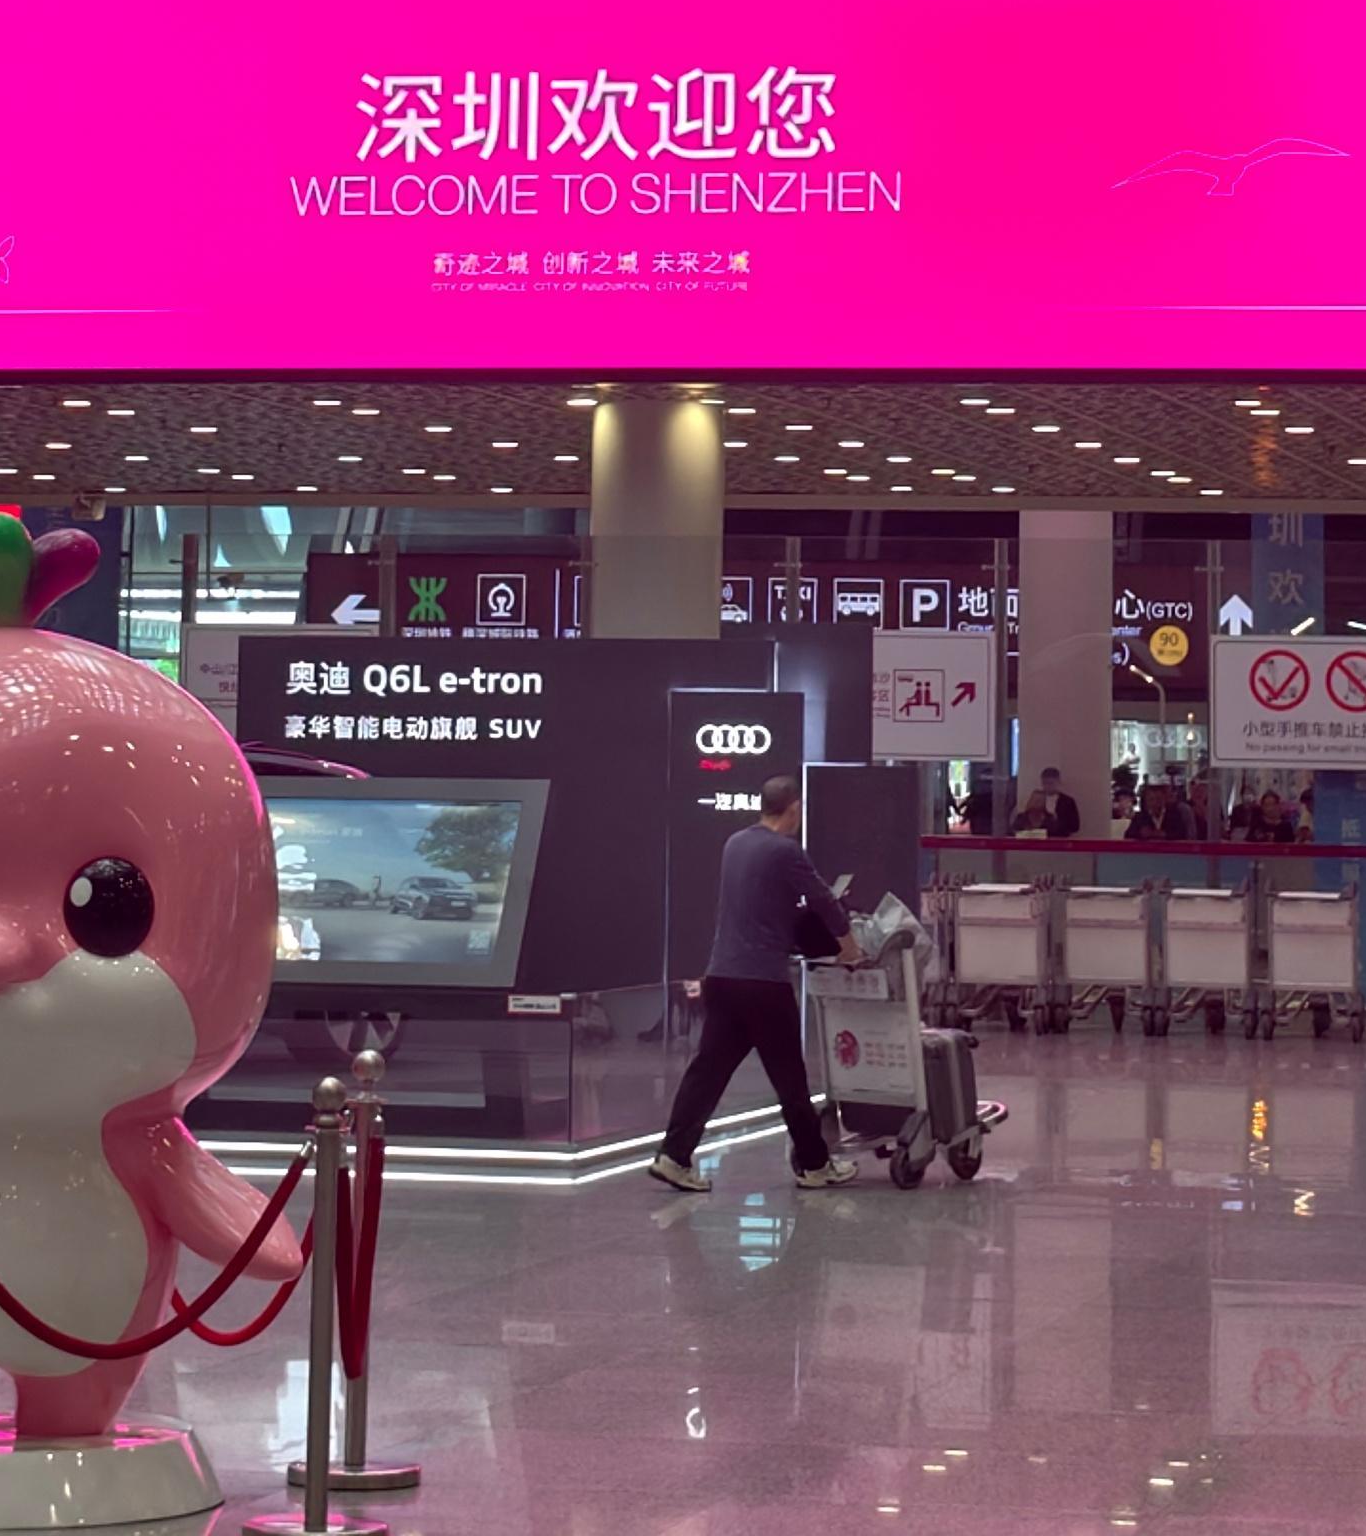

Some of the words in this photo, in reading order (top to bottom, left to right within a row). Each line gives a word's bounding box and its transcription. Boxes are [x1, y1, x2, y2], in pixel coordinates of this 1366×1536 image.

[356, 67, 837, 162] 深圳欢迎您
[290, 174, 539, 216] WELCOME
[551, 172, 617, 214] TO
[629, 171, 902, 214] SHENZHEN
[433, 251, 530, 276] 奇迹之城
[542, 250, 639, 275] 创新之城
[651, 250, 750, 274] 未来之城
[1159, 632, 1179, 648] 90
[286, 661, 352, 695] 奥迪
[363, 663, 431, 698] Q6L
[438, 664, 544, 695] e-tron
[284, 715, 479, 741] 豪华智能电动旗舰
[489, 719, 543, 739] SUV
